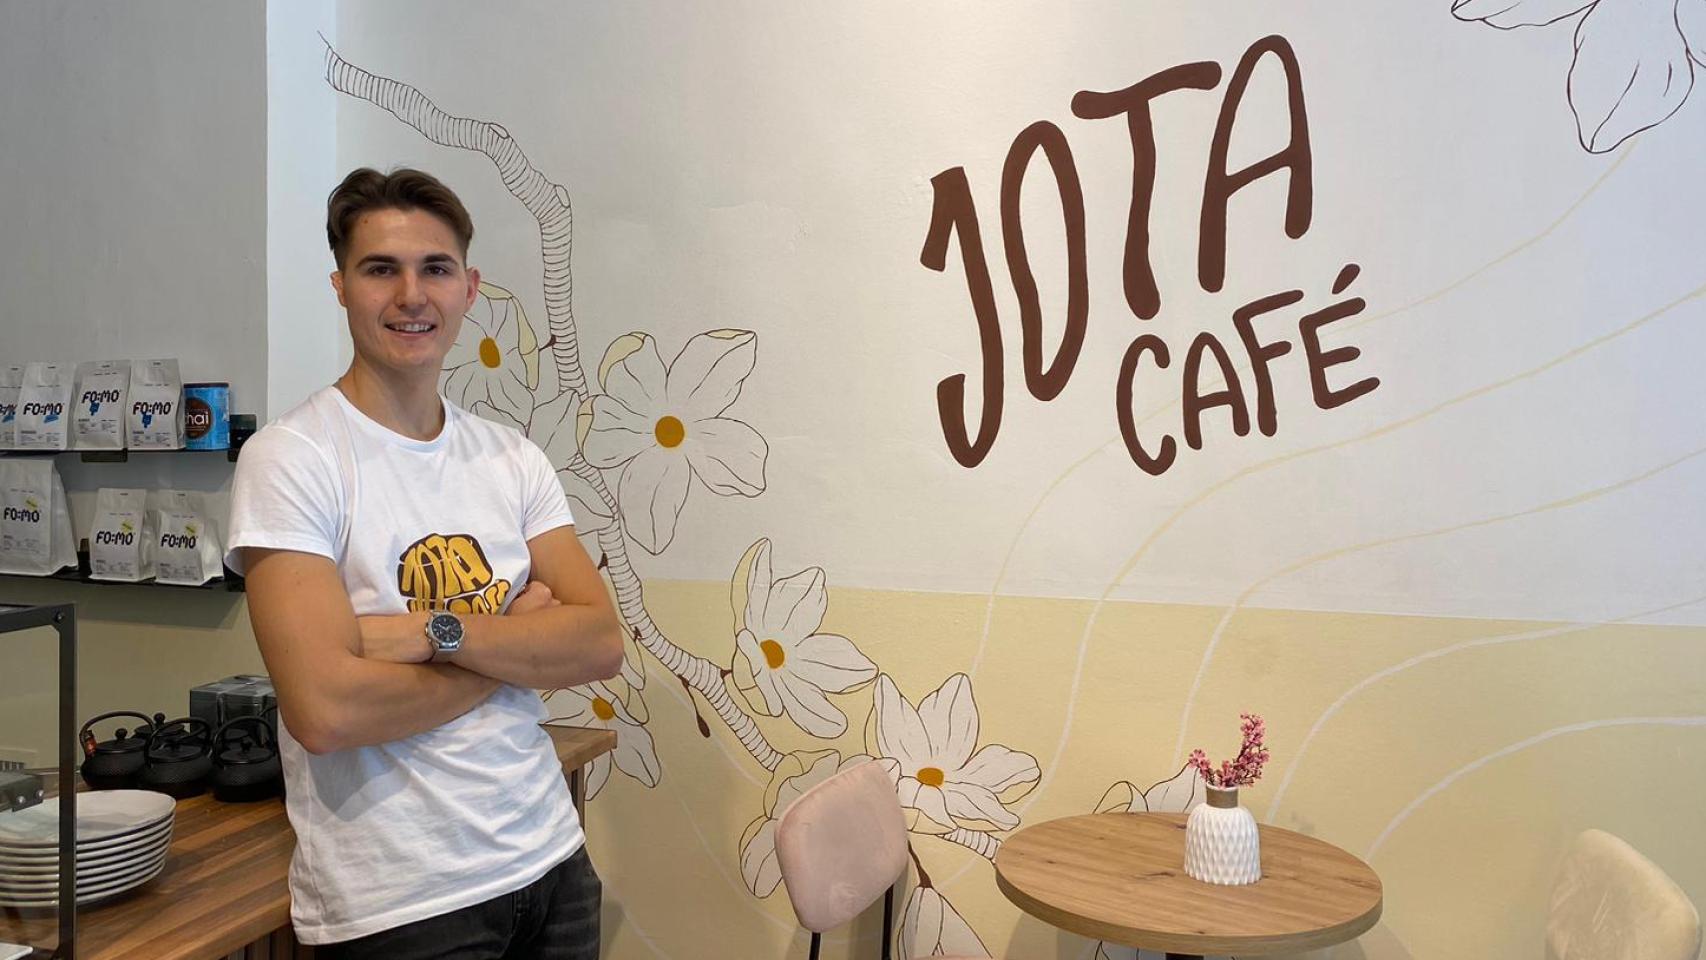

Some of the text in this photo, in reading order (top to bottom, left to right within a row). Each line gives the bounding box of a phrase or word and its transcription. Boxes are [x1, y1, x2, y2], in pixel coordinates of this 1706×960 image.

[920, 34, 1313, 468] JOTA
[185, 411, 209, 425] hai
[1116, 263, 1381, 477] CAFÉ
